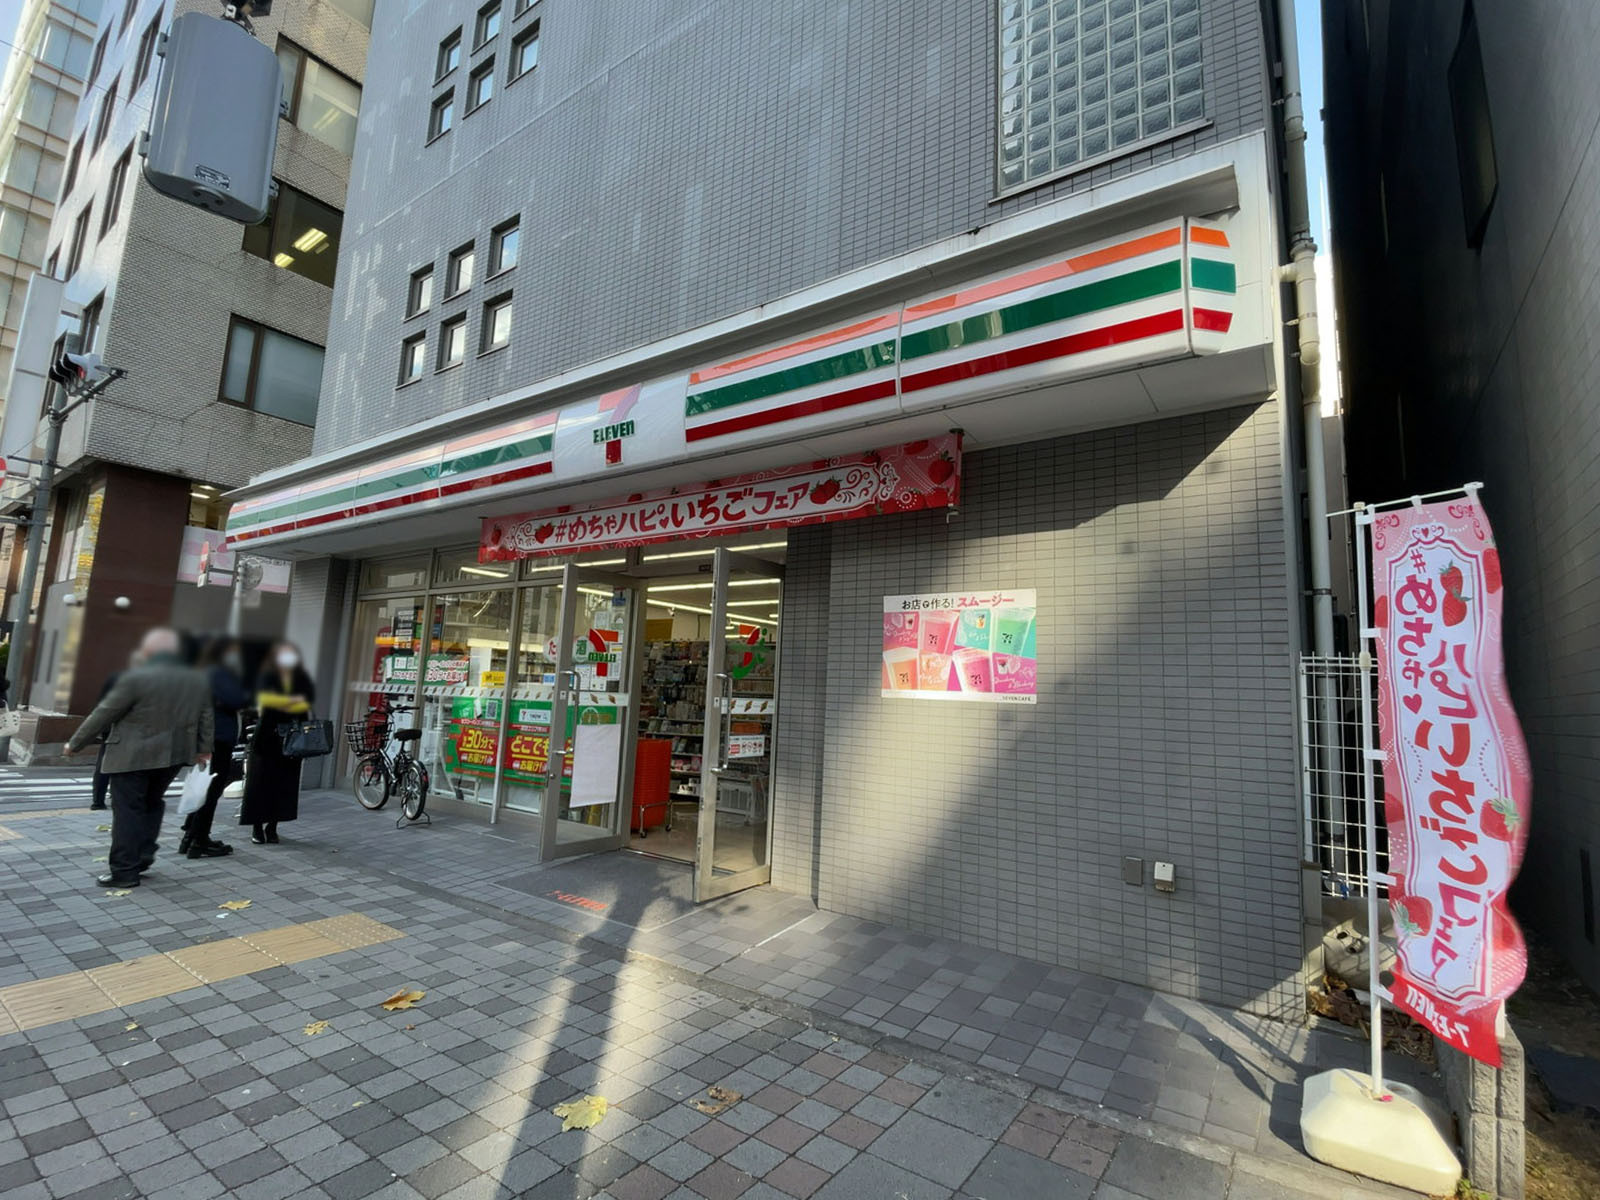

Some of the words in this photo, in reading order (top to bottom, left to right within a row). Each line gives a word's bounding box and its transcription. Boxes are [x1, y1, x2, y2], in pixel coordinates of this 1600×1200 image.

[958, 594, 1014, 607] スムージー
